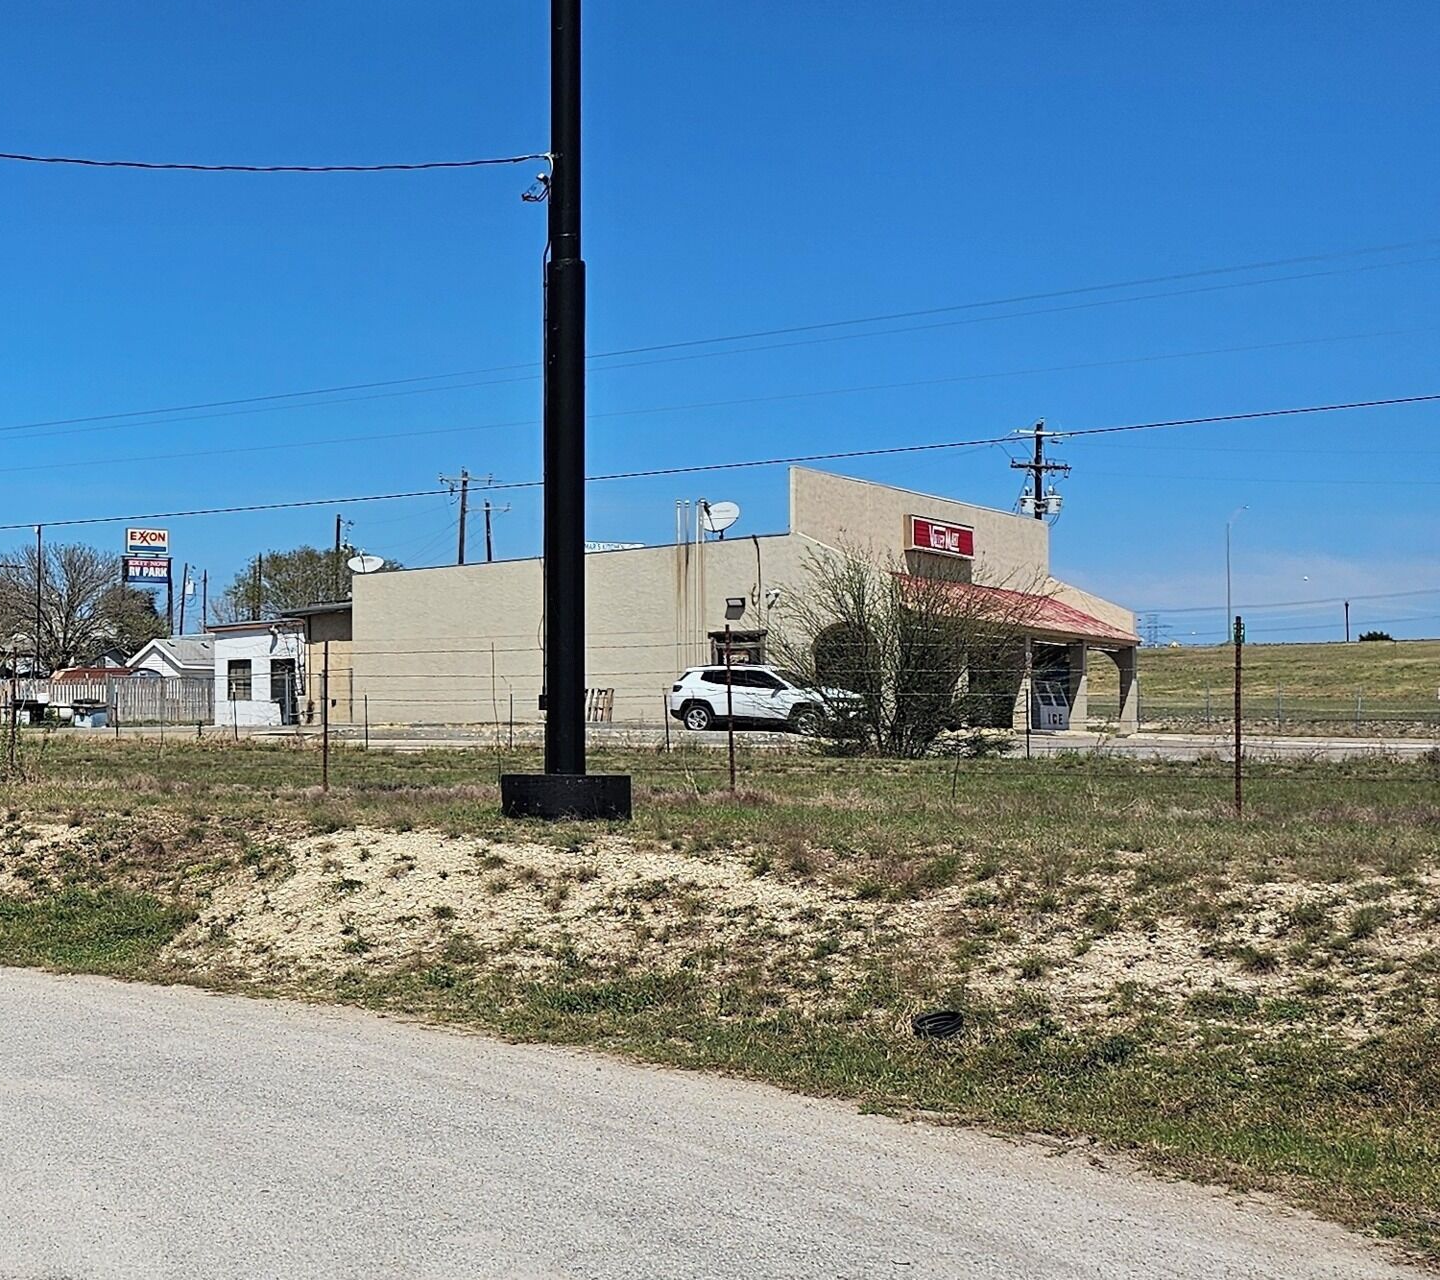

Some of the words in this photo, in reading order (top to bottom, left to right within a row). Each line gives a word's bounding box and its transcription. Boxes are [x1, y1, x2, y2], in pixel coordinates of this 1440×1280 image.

[130, 531, 166, 545] EXXON
[129, 566, 141, 577] RV
[142, 567, 168, 578] PARK
[1048, 713, 1063, 725] ICE
